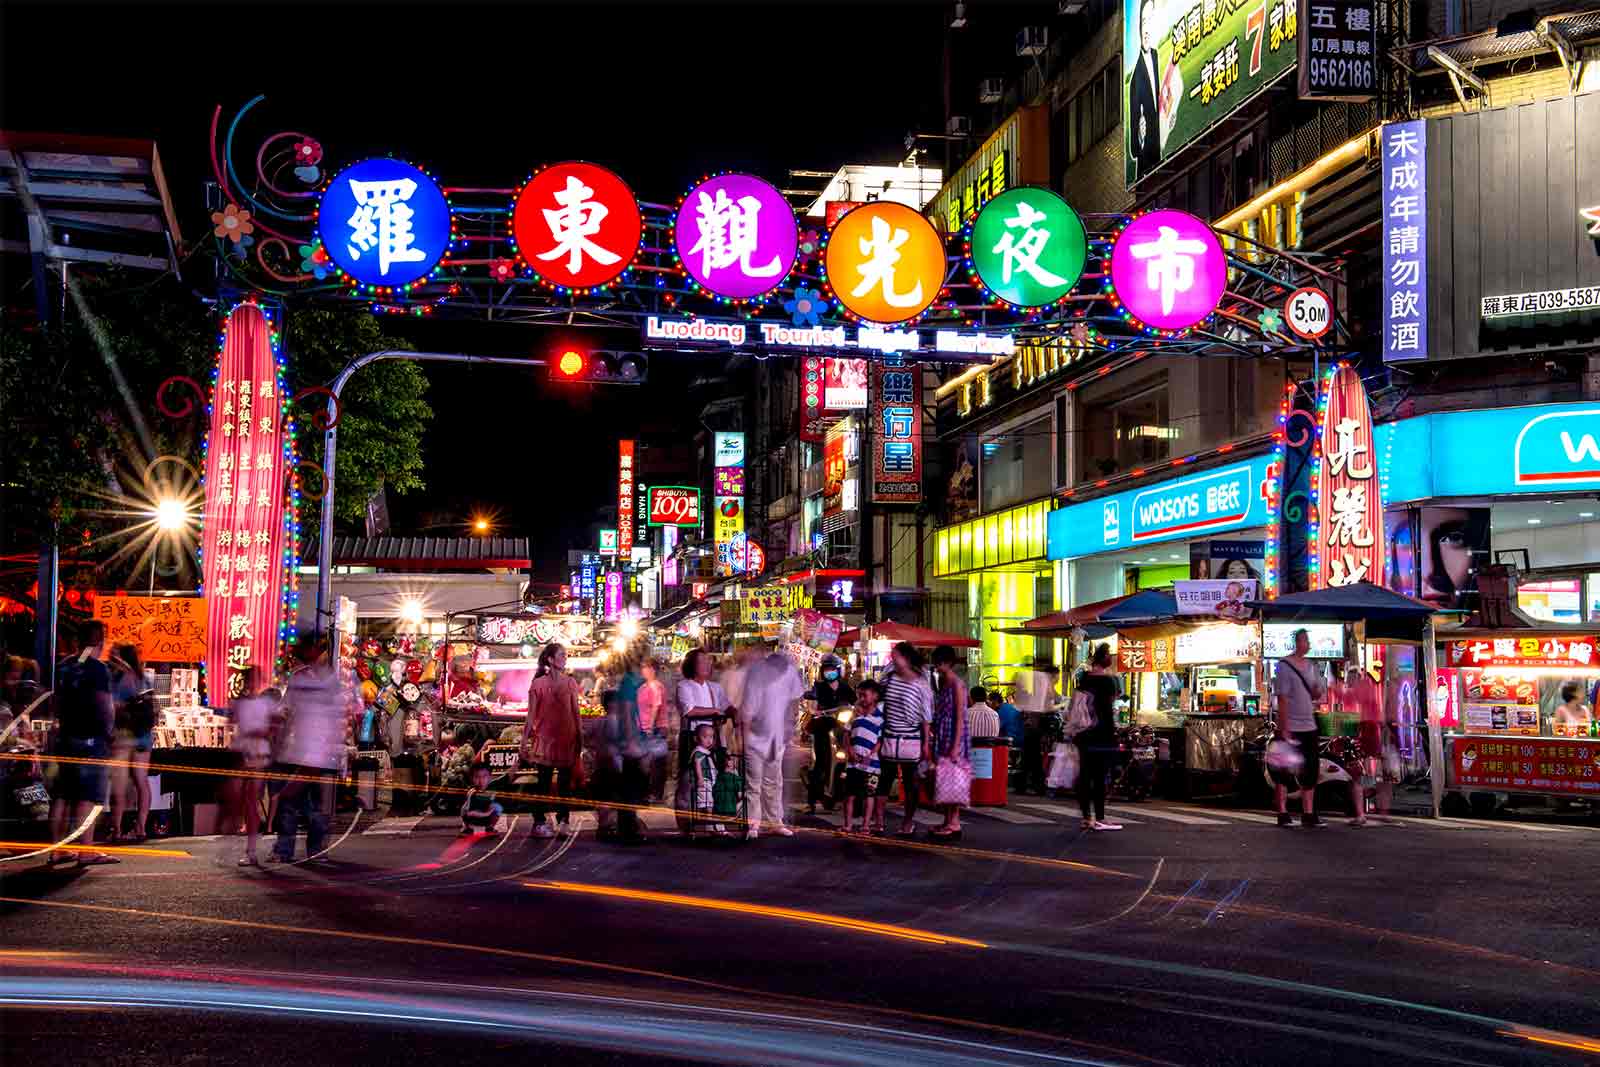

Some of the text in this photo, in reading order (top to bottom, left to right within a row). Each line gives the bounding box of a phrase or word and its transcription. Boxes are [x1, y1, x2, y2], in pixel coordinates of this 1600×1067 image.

[1311, 6, 1371, 31] 五樓
[1246, 5, 1266, 77] 7
[1311, 38, 1371, 55] 訂房專線
[1310, 57, 1371, 88] 9562186
[347, 176, 1208, 317] 羅東觀光夜市
[1389, 129, 1419, 351] 未成年請勿飲酒
[648, 316, 744, 345] Luodong
[761, 324, 845, 346] Tourist
[651, 496, 689, 521] 109
[1140, 493, 1199, 526] watsons
